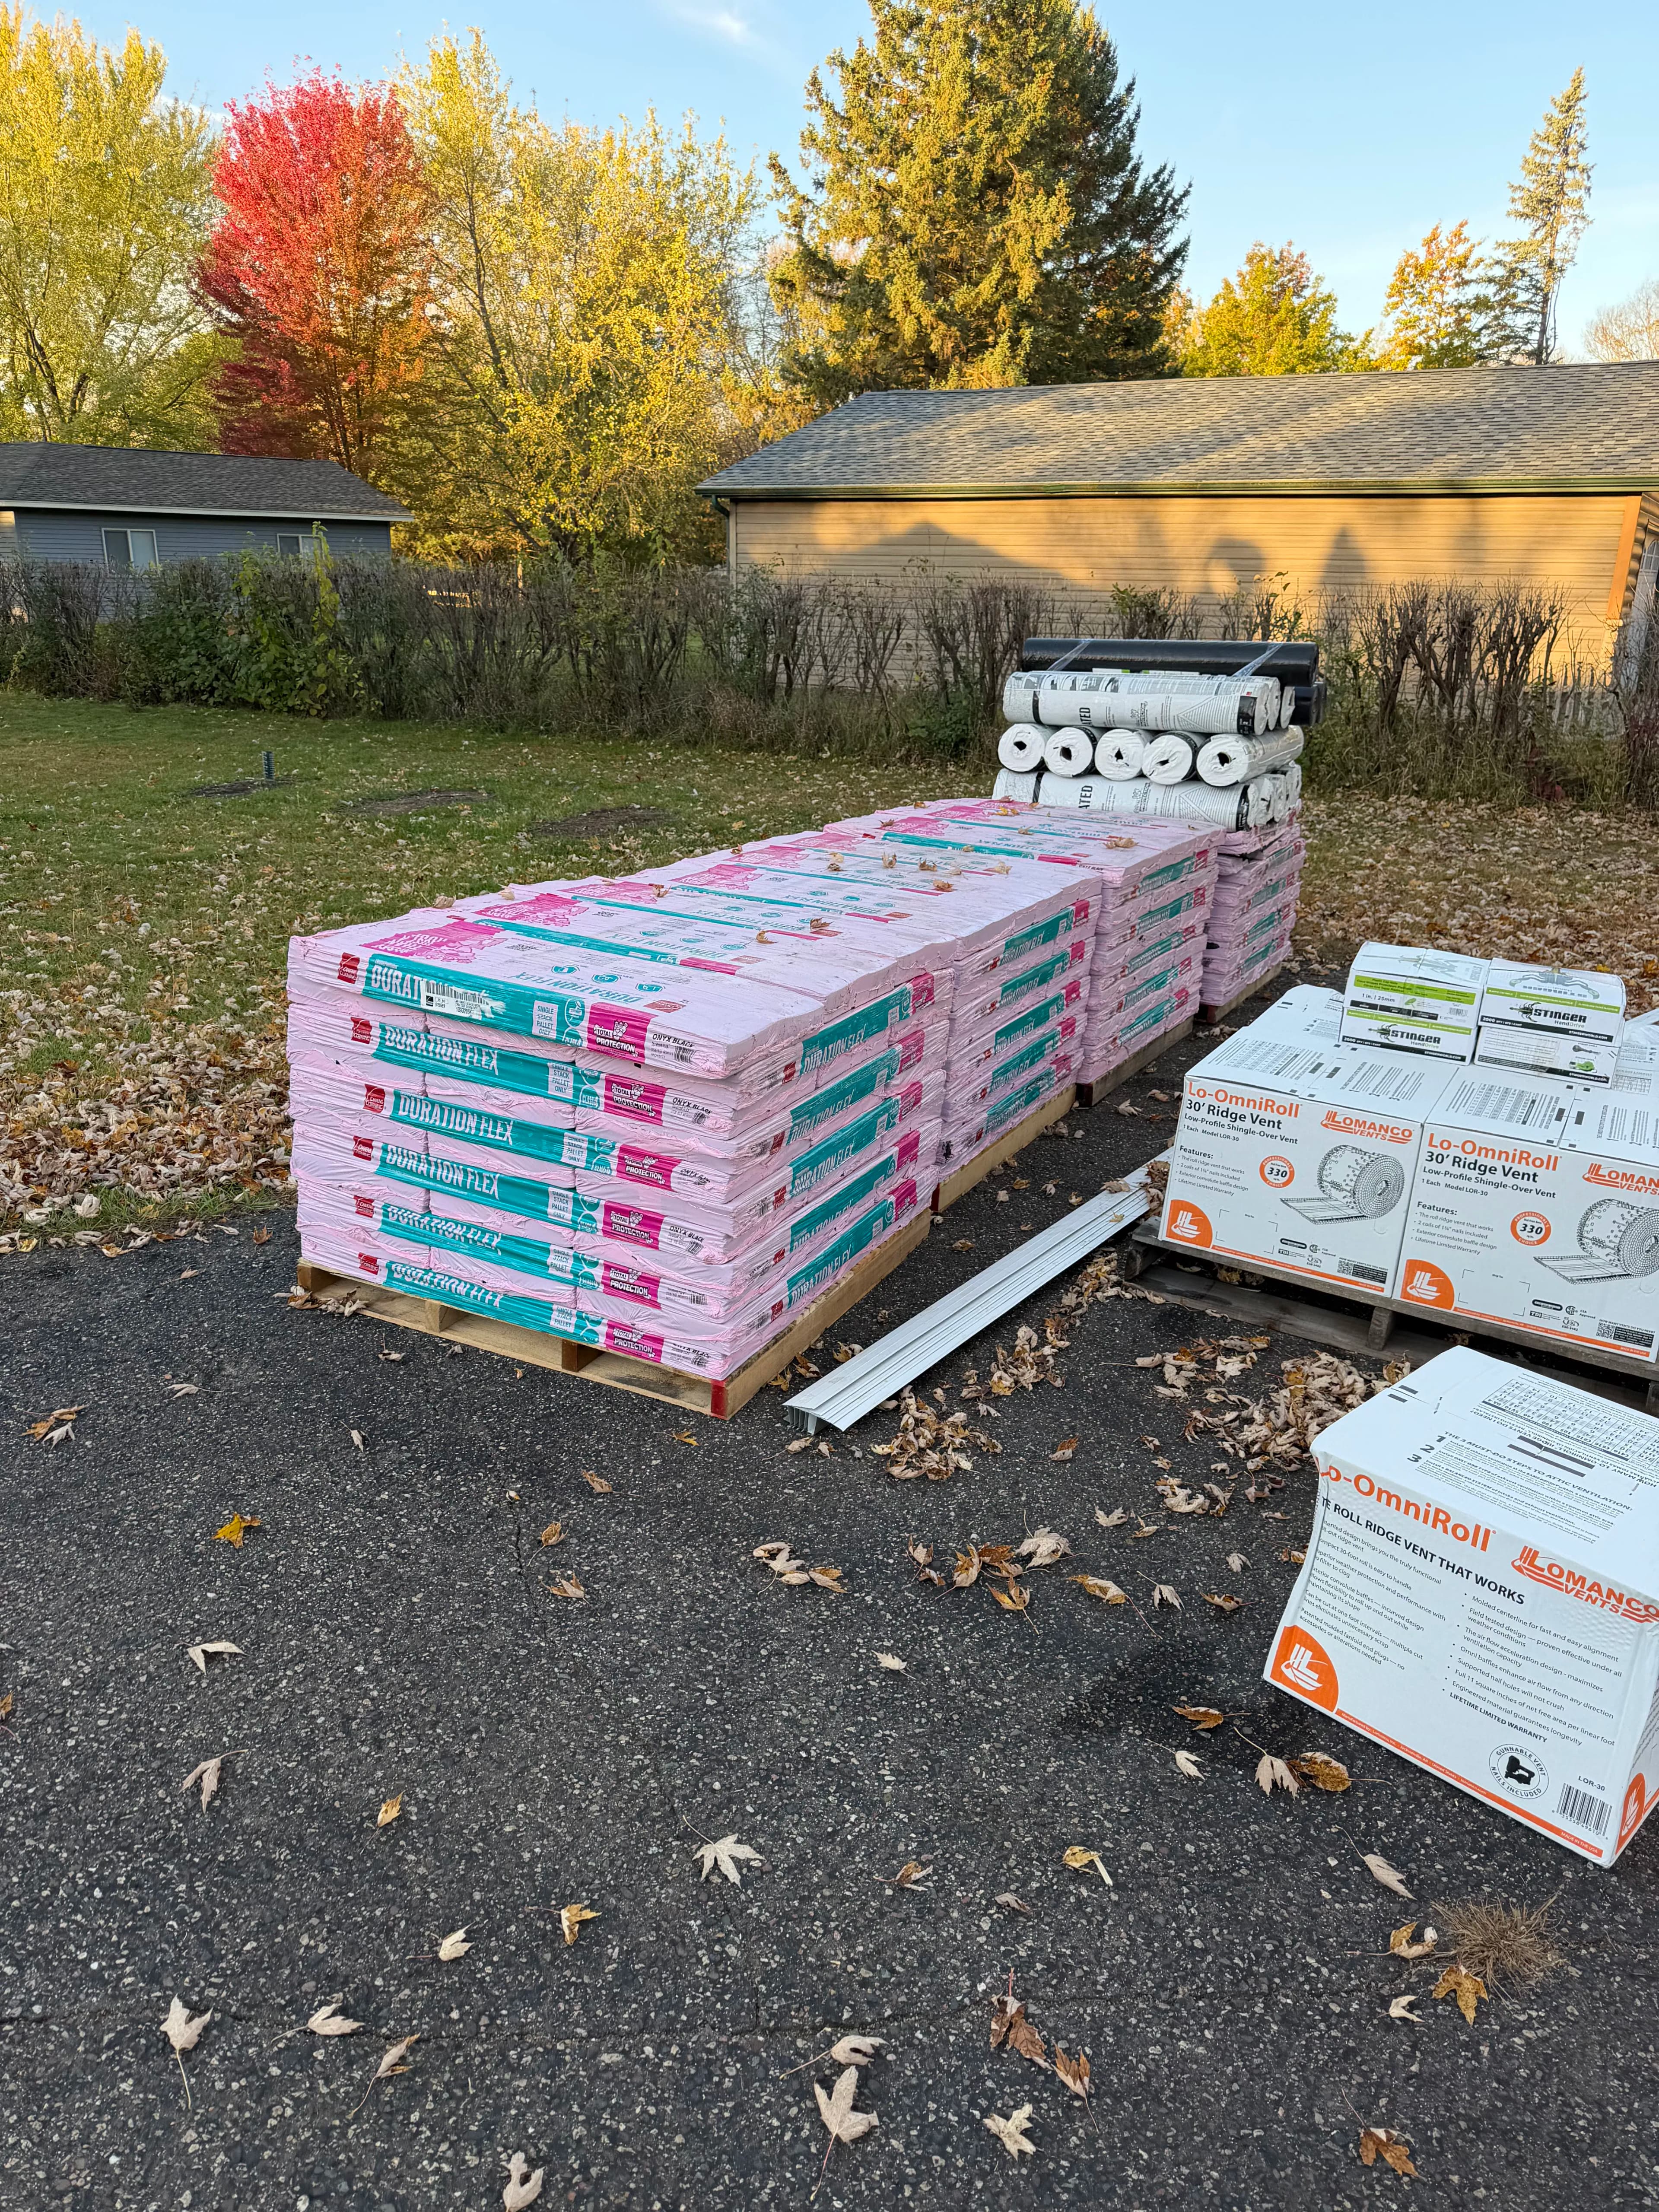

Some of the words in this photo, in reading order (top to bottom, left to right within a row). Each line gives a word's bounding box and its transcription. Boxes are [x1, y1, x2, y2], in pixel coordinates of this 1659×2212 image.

[537, 1005, 554, 1014] SINGLE
[1534, 1008, 1587, 1023] STINGER
[1554, 1020, 1585, 1028] HandDrive
[597, 1028, 611, 1037] TOTAL
[653, 1033, 671, 1042] ONYX
[673, 1038, 694, 1048] BLACK
[1391, 1030, 1441, 1044] STINGER
[385, 1023, 462, 1062] DURATION
[465, 1046, 499, 1076] FLEX
[596, 1038, 636, 1052] PROTECTION
[553, 1078, 569, 1087] PALLET
[613, 1096, 653, 1111] PROTECTION
[673, 1097, 691, 1106] ONYX
[692, 1104, 712, 1115] BLACK
[1189, 1083, 1299, 1117] Lo-OmniRoll
[398, 1094, 477, 1130] DURATION
[480, 1116, 513, 1145] FLEX
[1208, 1104, 1246, 1122] Ridge
[1250, 1113, 1282, 1129] Vent
[1185, 1113, 1225, 1128] Low-Profile
[1227, 1124, 1277, 1139] Shingle-Over
[1276, 1135, 1297, 1144] Vent
[1326, 1112, 1412, 1138] LOMANCO
[567, 1148, 583, 1157] PALLET
[1180, 1145, 1213, 1159] Features:
[1429, 1134, 1558, 1170] Lo-OmniRoll
[386, 1145, 464, 1186] DURATION
[466, 1170, 499, 1199] FLEX
[626, 1166, 662, 1179] PROTECTION
[1267, 1167, 1288, 1179] 330
[1452, 1156, 1497, 1175] Ridge
[1502, 1165, 1538, 1182] Vent
[1424, 1166, 1472, 1182] Low-Profile
[1474, 1177, 1533, 1193] Shingle-Over
[1535, 1189, 1556, 1198] Vent
[1619, 1182, 1658, 1195] VENTS
[1465, 1188, 1487, 1196] LOR-30
[552, 1204, 569, 1212] PALLET
[1417, 1201, 1457, 1215] Features:
[612, 1224, 651, 1240] PROTECTION
[670, 1225, 686, 1234] ONYX
[688, 1232, 704, 1242] BLACK
[1519, 1222, 1543, 1235] 330
[1434, 1233, 1462, 1242] convolute
[1518, 1237, 1538, 1246] CHOICE
[613, 1271, 627, 1280] TOTAL
[610, 1281, 648, 1296] PROTECTION
[616, 1329, 630, 1338] TOTAL
[614, 1338, 652, 1353] PROTECTION
[1467, 1442, 1506, 1459] MUST-DO
[1506, 1459, 1532, 1470] STEPS
[1545, 1475, 1571, 1486] ATTIC
[1573, 1484, 1632, 1510] VENTILATION:
[1334, 1504, 1362, 1526] ROLL
[1366, 1520, 1402, 1545] RIDGE
[1405, 1539, 1436, 1562] VENT
[1439, 1557, 1472, 1580] THAT
[1475, 1574, 1524, 1604] WORKS
[1519, 1545, 1659, 1618] LOMANCO
[1564, 1583, 1624, 1614] VENTS
[1468, 1616, 1492, 1630] weather
[1494, 1629, 1526, 1646] conditions
[1472, 1596, 1496, 1610] Molded
[1497, 1609, 1527, 1626] centerline
[1540, 1626, 1551, 1635] fast
[1567, 1639, 1582, 1648] easy
[1583, 1645, 1618, 1662] alignment
[1470, 1608, 1484, 1618] Field
[1486, 1616, 1504, 1628] tested
[1505, 1626, 1526, 1639] design
[1537, 1640, 1560, 1652] proven
[1562, 1650, 1590, 1664] effective
[1592, 1662, 1612, 1673] under
[1464, 1635, 1495, 1654] ventilation
[1497, 1653, 1522, 1667] capacity
[1465, 1627, 1476, 1636] The
[1486, 1637, 1500, 1647] flow
[1500, 1646, 1538, 1665] acceleration
[1540, 1662, 1562, 1675] design
[1568, 1675, 1602, 1691] maximizes
[1461, 1646, 1477, 1658] Omni
[1478, 1655, 1497, 1668] baffles
[1499, 1667, 1526, 1681] enhance
[1537, 1682, 1551, 1691] flow
[1553, 1689, 1568, 1699] from
[1570, 1697, 1582, 1706] any
[1583, 1703, 1613, 1719] direction
[1450, 1692, 1478, 1710] LIFETIME
[1480, 1708, 1506, 1724] LIMITED
[1508, 1722, 1547, 1742] WARRANTY
[1496, 1746, 1533, 1759] GUNNABLE
[1533, 1758, 1546, 1777] VENT
[1490, 1766, 1506, 1787] NAILS
[1506, 1786, 1542, 1797] INCLUDED
[1578, 1775, 1605, 1791] LOR-30
